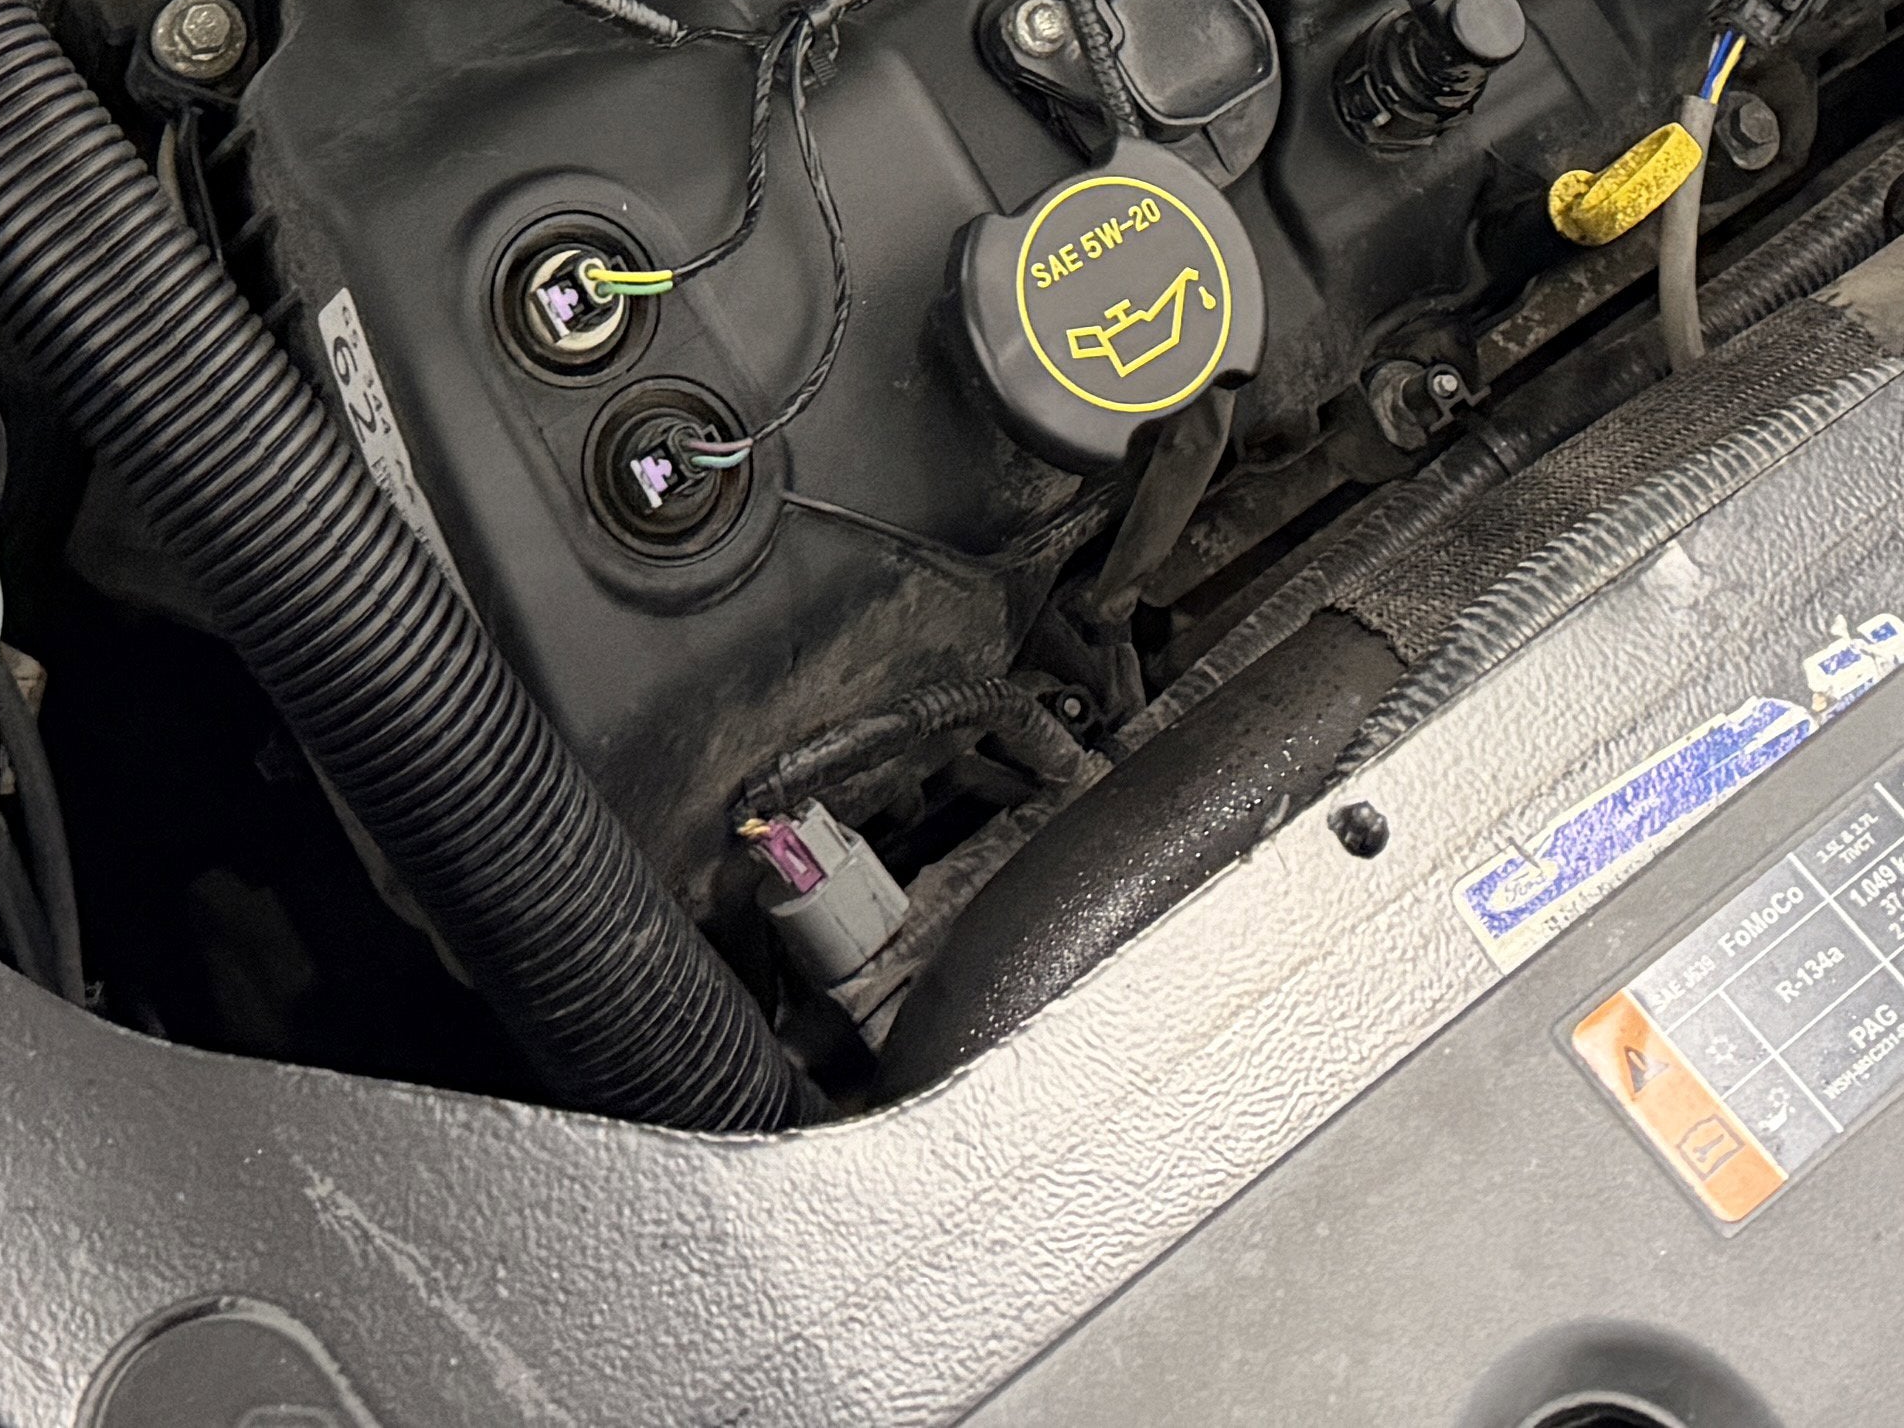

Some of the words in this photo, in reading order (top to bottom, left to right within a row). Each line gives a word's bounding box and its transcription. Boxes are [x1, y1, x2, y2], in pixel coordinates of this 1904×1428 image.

[1031, 247, 1085, 290] SAE
[1085, 197, 1163, 261] 5W-20
[1846, 865, 1897, 913] 1.049
[1645, 977, 1686, 1016] SAE
[1678, 952, 1718, 990] J639
[1717, 879, 1809, 960] FoMoCo
[1773, 940, 1848, 1006] R-134a
[1846, 999, 1901, 1051] PAG
